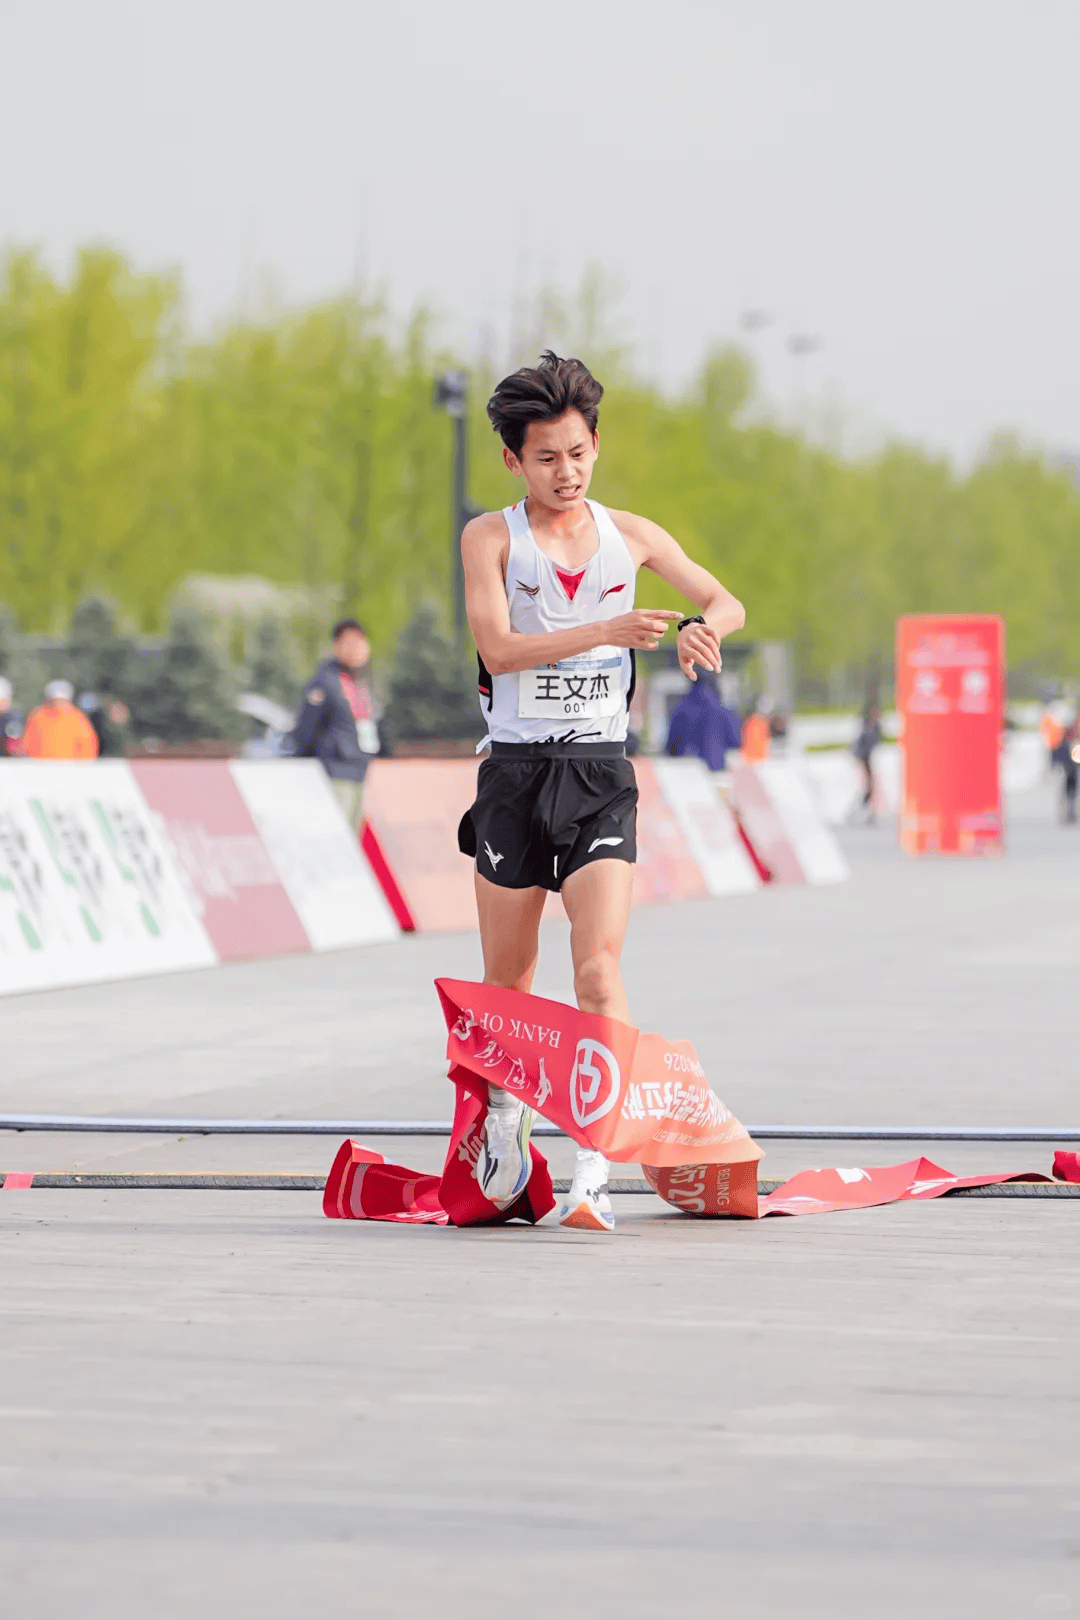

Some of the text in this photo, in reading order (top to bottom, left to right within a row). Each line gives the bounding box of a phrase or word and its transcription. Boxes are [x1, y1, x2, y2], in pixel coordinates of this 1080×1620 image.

[535, 673, 610, 701] 王文杰
[564, 702, 587, 714] 001
[479, 1011, 504, 1034] OF
[507, 1018, 562, 1049] BANK
[716, 1168, 731, 1206] BEIJING
